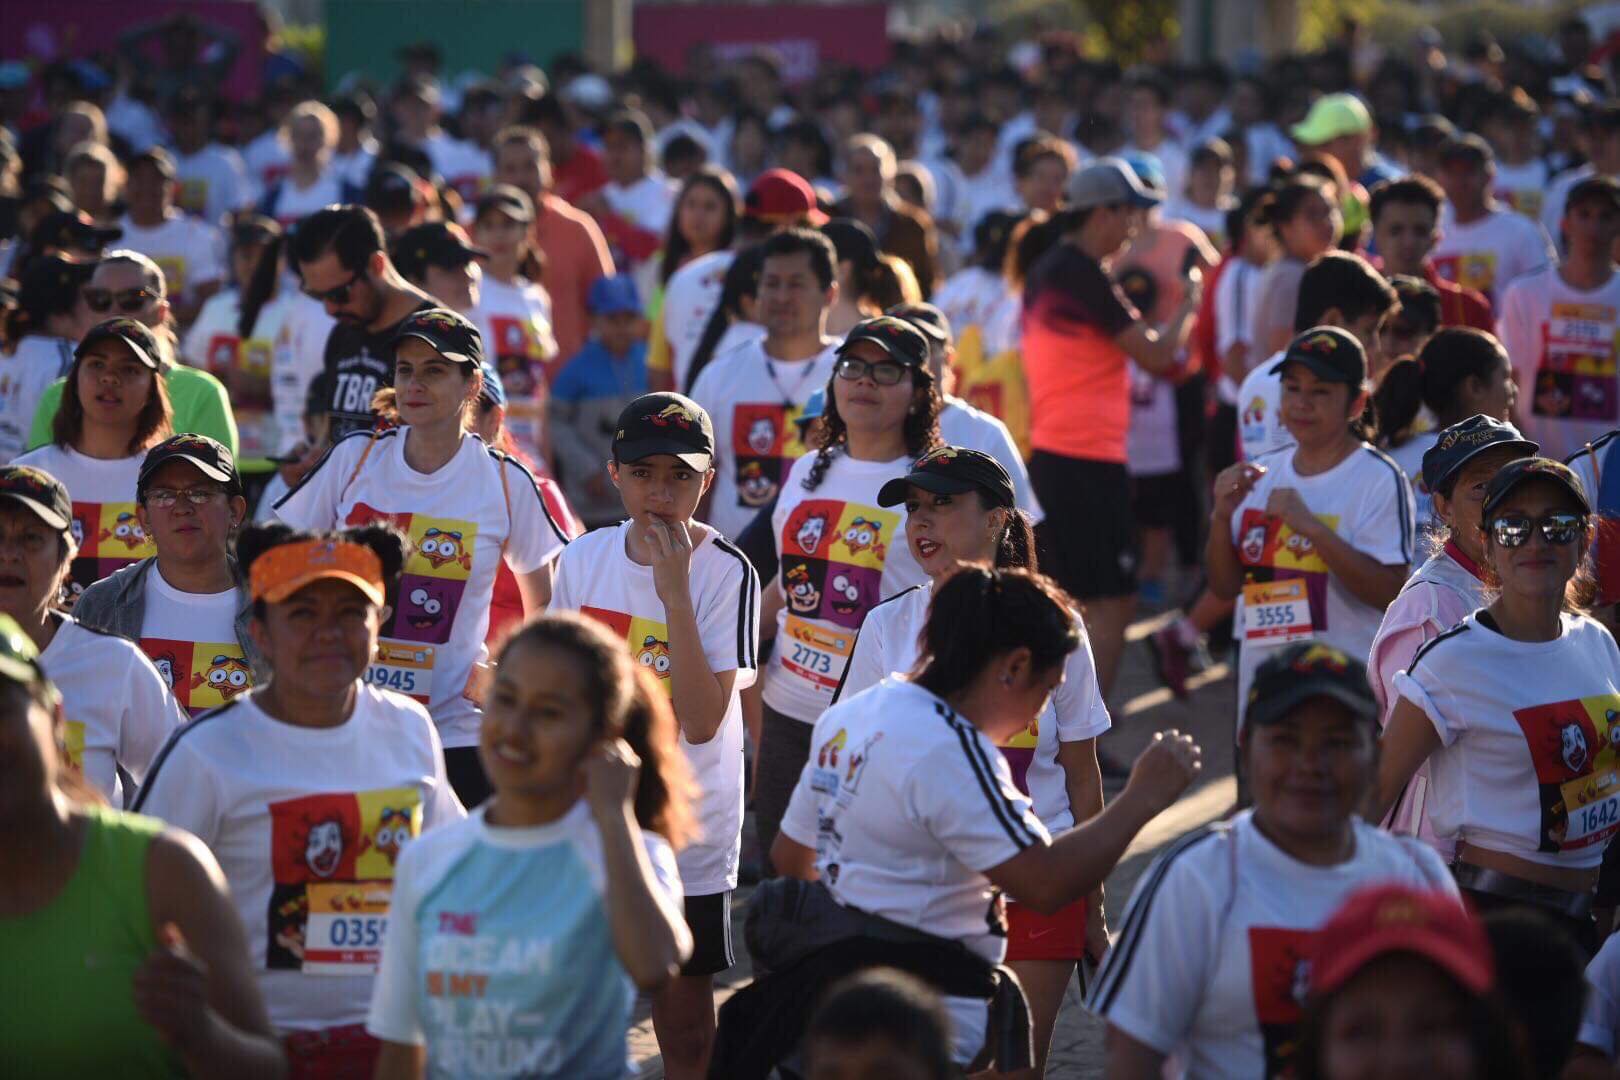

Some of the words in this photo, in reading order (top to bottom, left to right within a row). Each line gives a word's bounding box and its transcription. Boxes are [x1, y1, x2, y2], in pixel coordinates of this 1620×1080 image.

[333, 373, 377, 413] TBR
[1256, 604, 1295, 627] 3555
[791, 642, 832, 674] 2773
[362, 667, 416, 692] 0945
[1581, 798, 1618, 834] 1642
[437, 911, 479, 937] THE
[427, 936, 553, 976] OCEAN
[449, 976, 489, 998] MY
